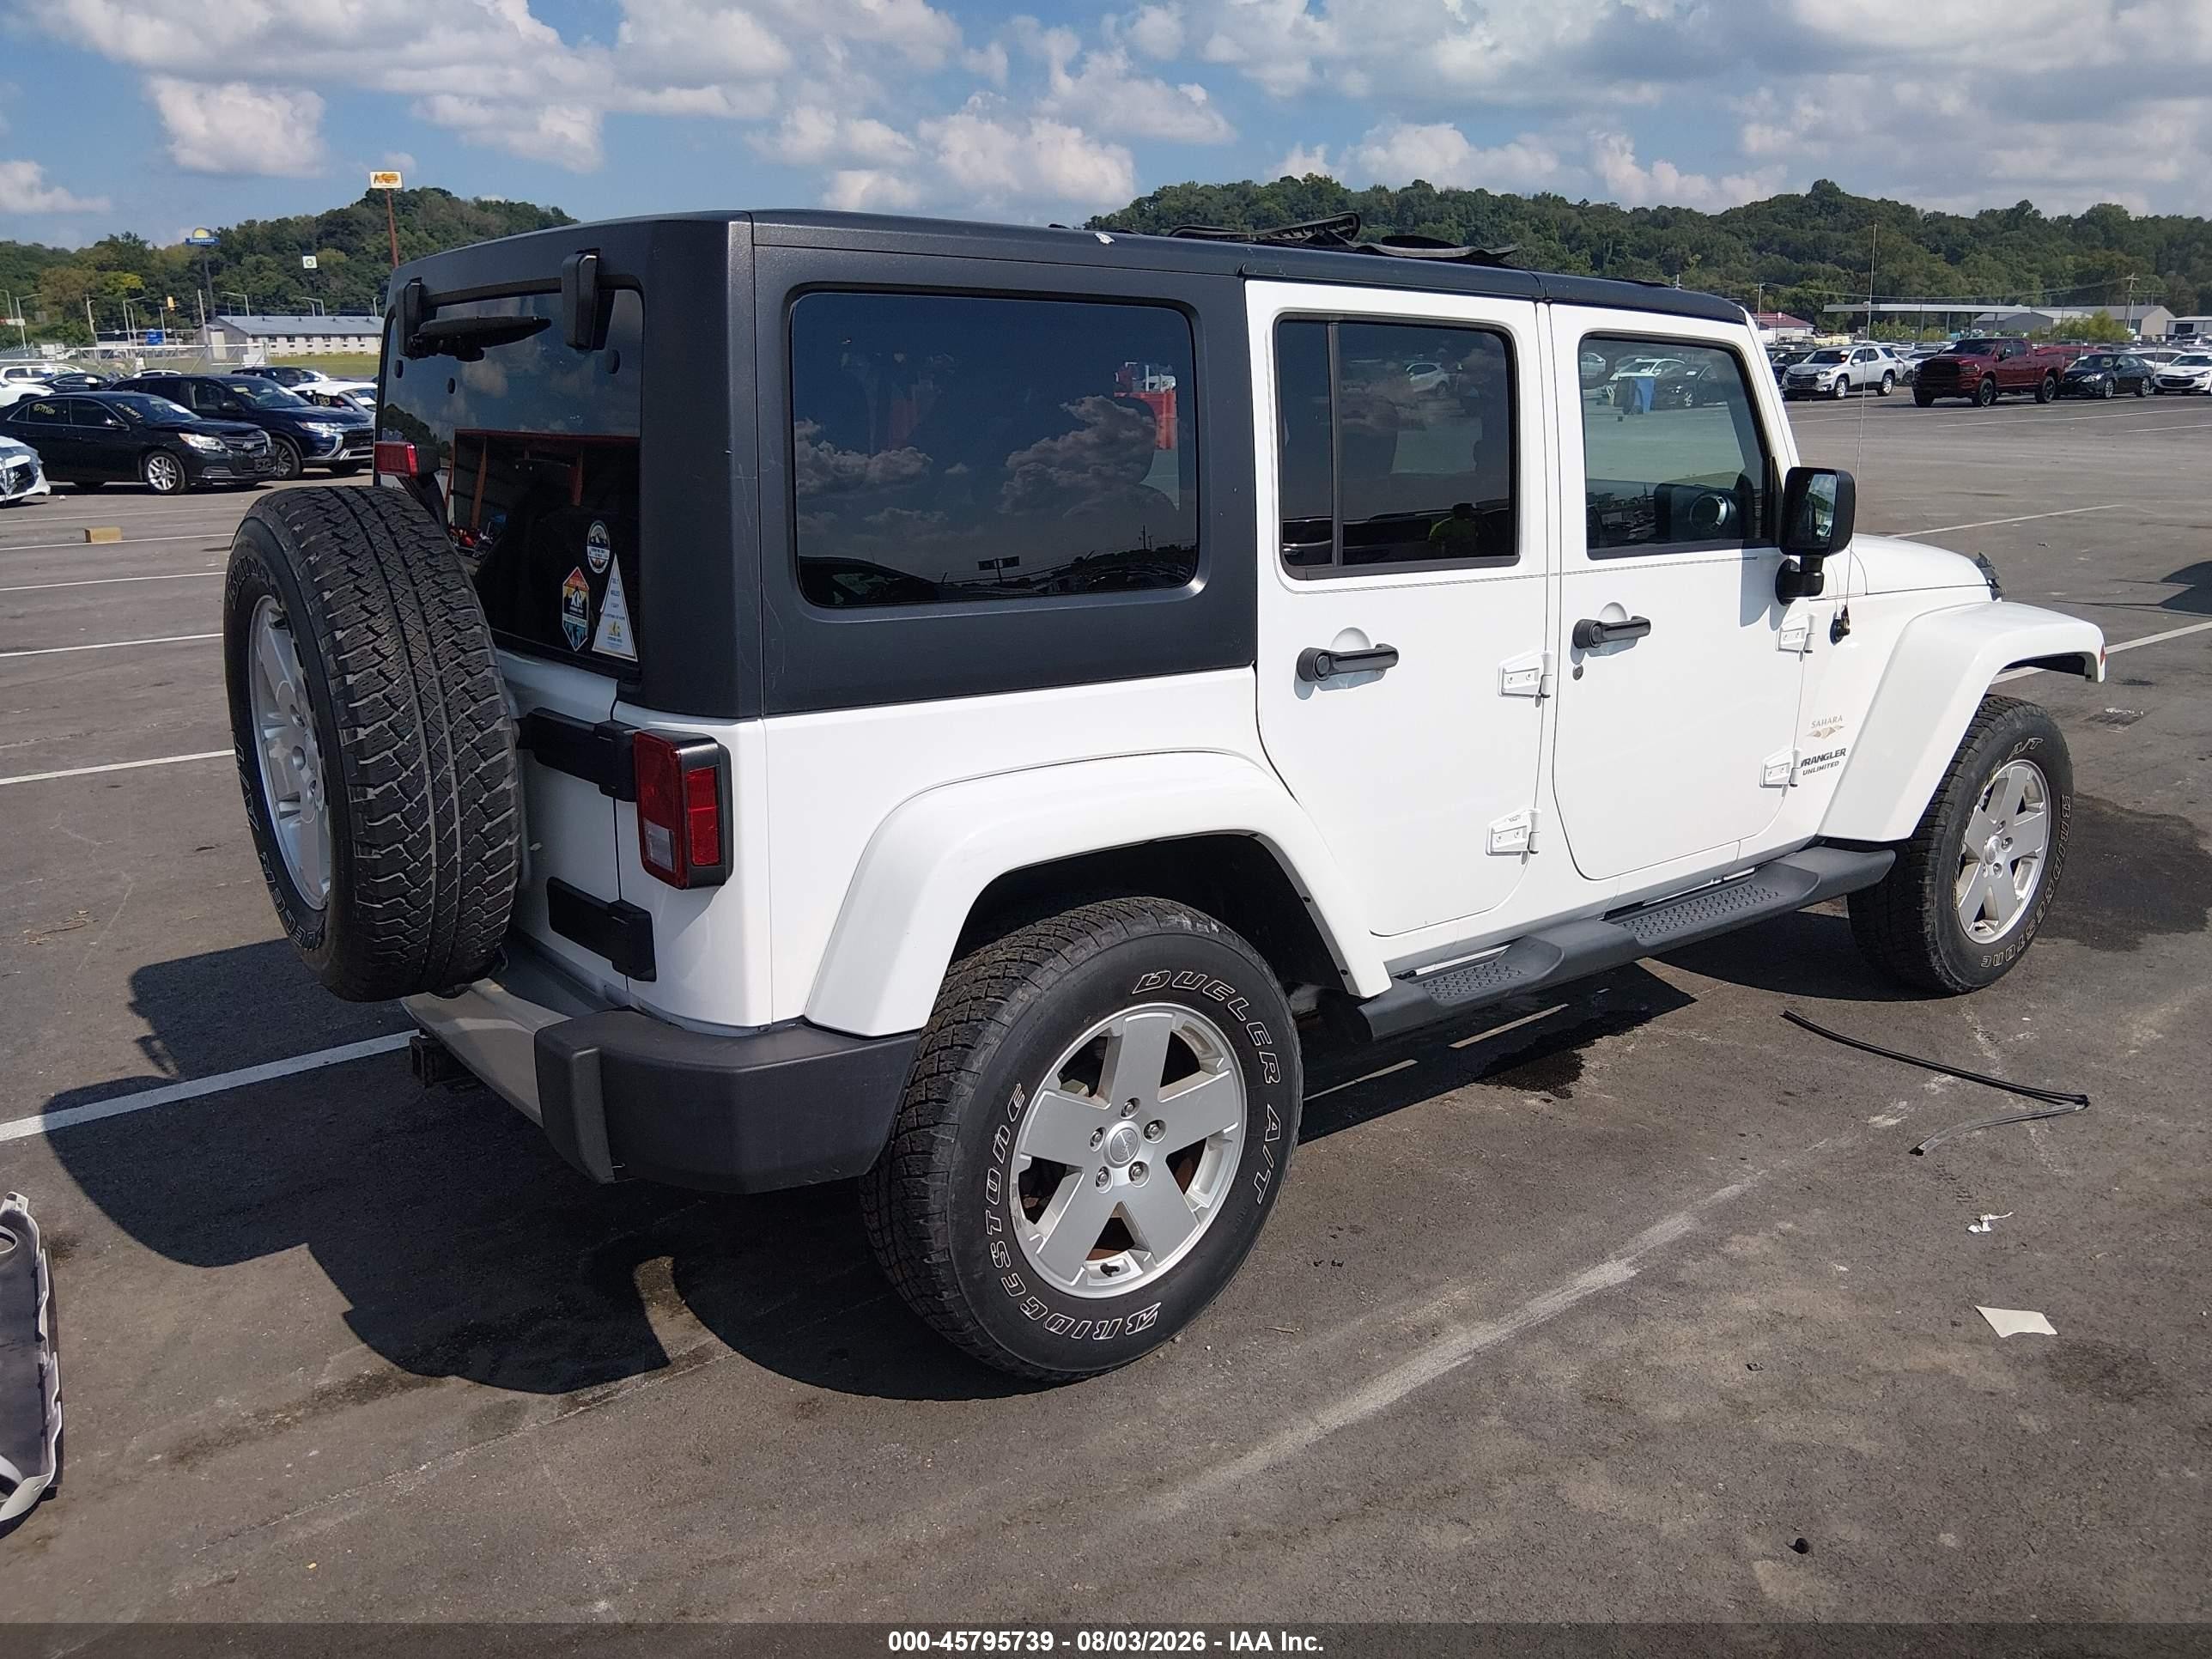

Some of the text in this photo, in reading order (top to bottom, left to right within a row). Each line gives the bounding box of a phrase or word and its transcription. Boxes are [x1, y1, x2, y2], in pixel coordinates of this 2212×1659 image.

[1802, 760, 1840, 776] UNLIMITED
[1811, 714, 1844, 728] SAHARA
[1980, 794, 2071, 968] BRIDGESTONE
[1130, 969, 1282, 1206] DUELER A/T
[984, 1081, 1163, 1340] BRIDGESTONE
